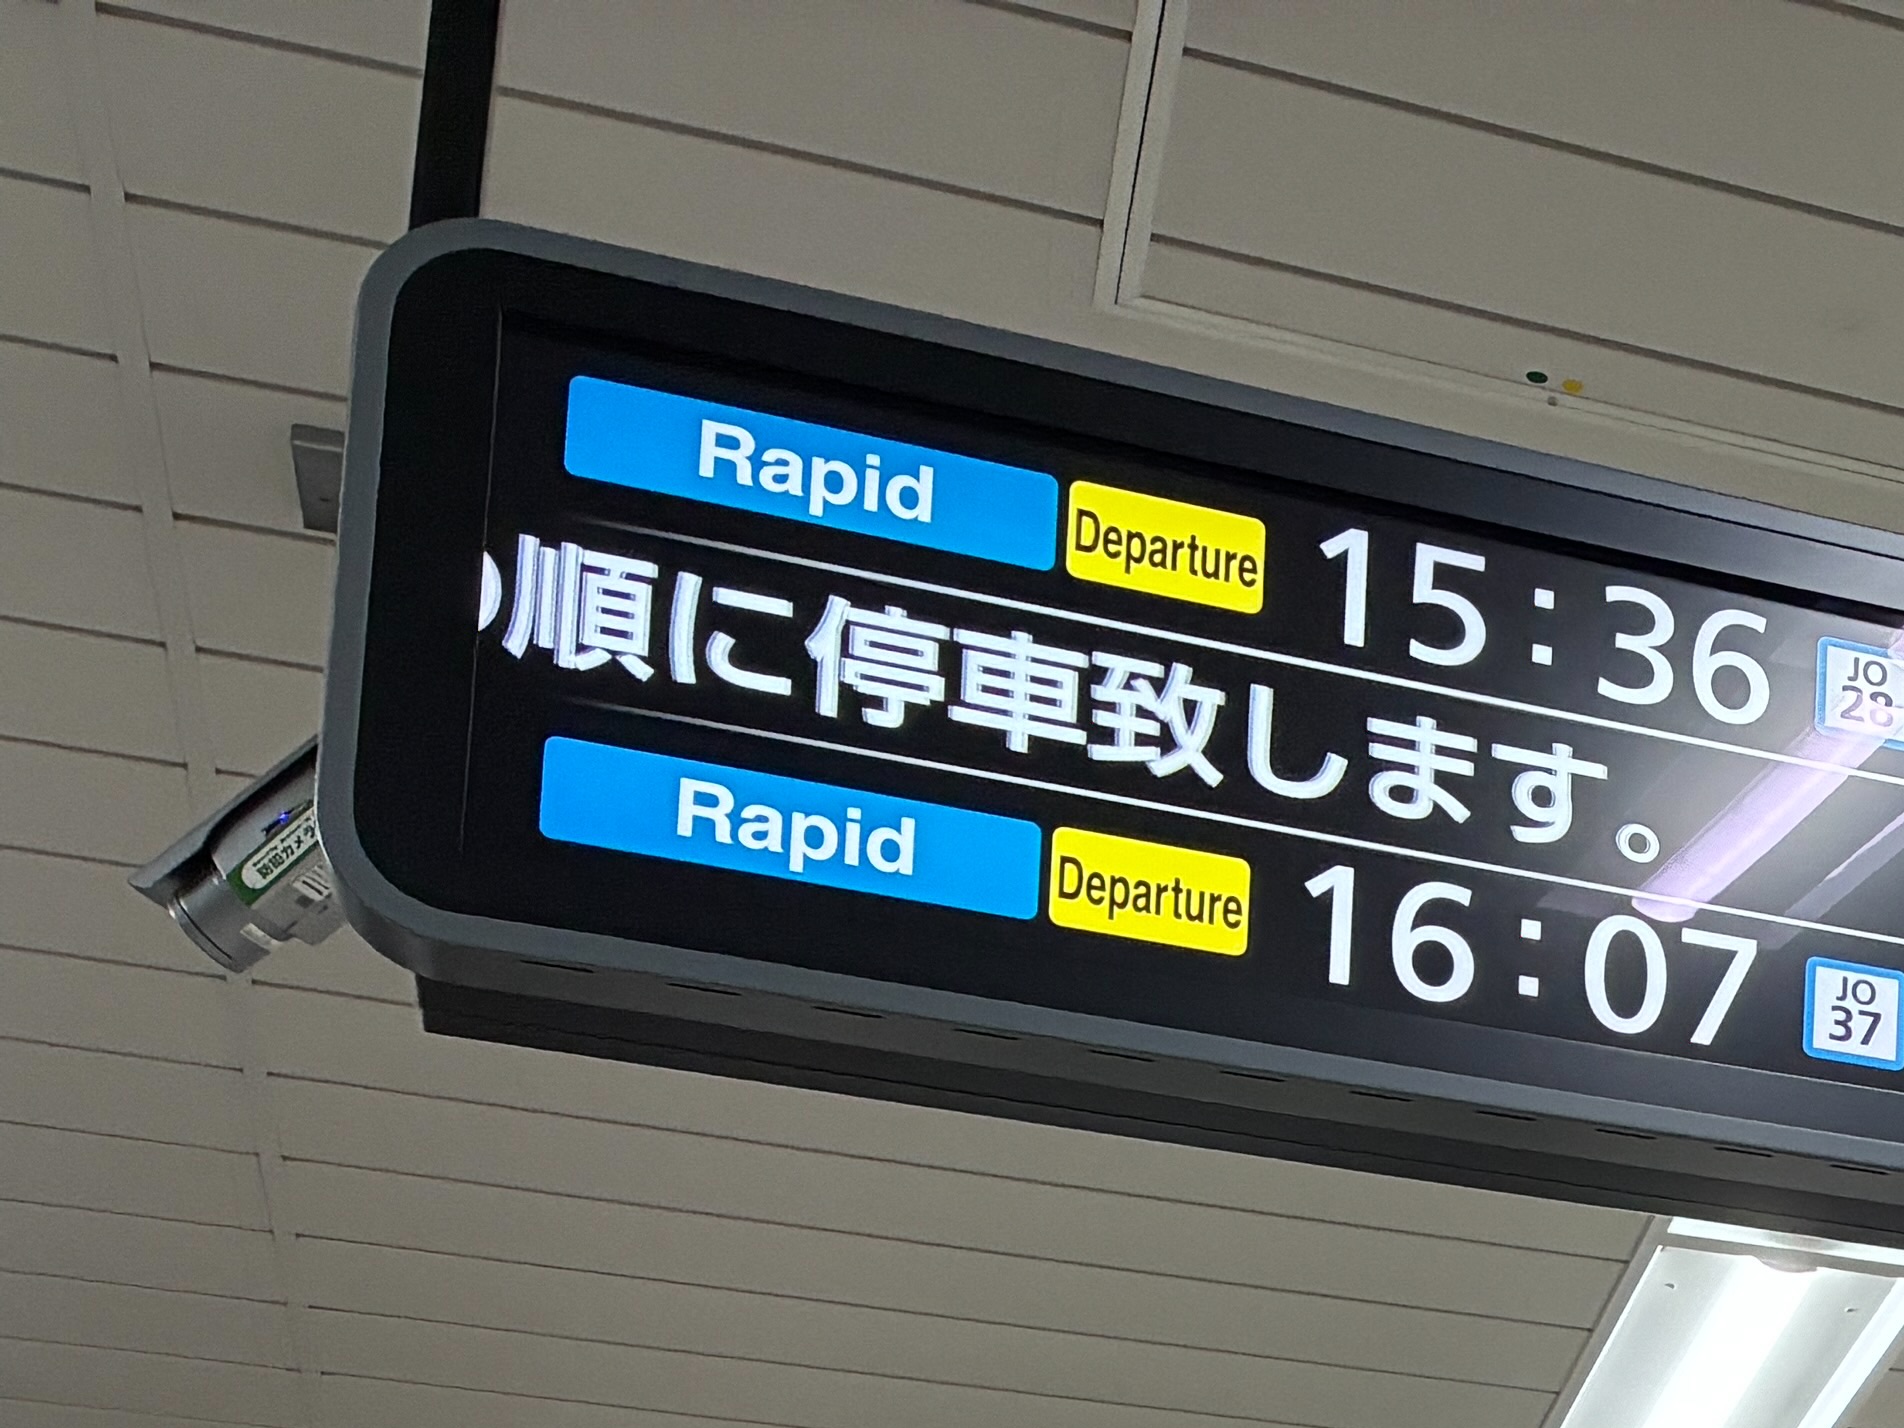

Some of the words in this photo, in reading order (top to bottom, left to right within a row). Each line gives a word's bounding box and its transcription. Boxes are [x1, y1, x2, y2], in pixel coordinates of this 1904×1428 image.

[696, 419, 934, 526] Rapid
[1073, 505, 1259, 591] Departure
[1317, 527, 1771, 726] 15:36
[478, 534, 1660, 866] 順に停車致します。
[1840, 686, 1892, 728] 28
[1848, 658, 1888, 686] JO
[675, 775, 915, 880] Rapid
[1057, 853, 1242, 934] Departure
[1305, 864, 1758, 1046] 16:07
[1838, 977, 1876, 1006] JO
[1828, 1006, 1881, 1047] 37
